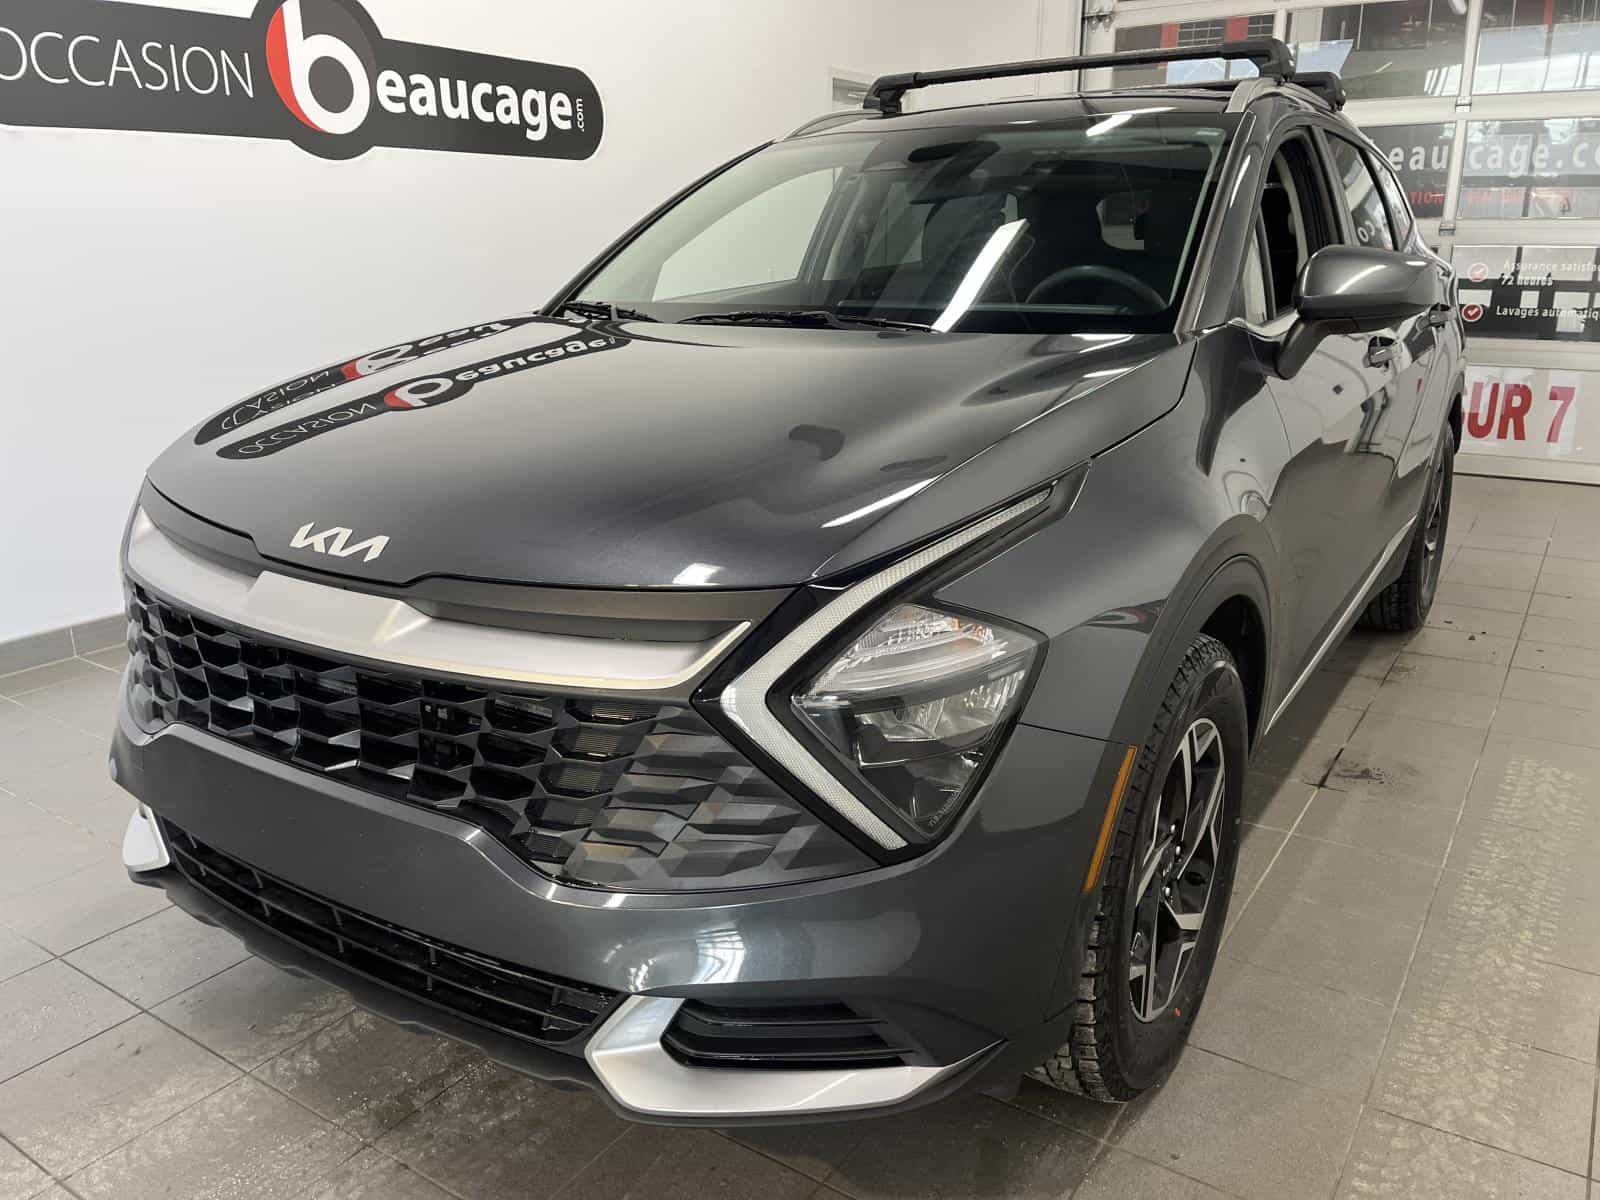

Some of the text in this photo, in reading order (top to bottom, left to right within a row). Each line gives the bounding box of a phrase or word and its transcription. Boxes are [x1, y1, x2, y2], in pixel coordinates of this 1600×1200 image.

[0, 26, 254, 98] OCCASION
[576, 98, 585, 132] .com
[1501, 275, 1514, 285] 72
[1496, 305, 1539, 318] Lavages
[1461, 381, 1577, 444] UR 7
[289, 521, 390, 563] KIA
